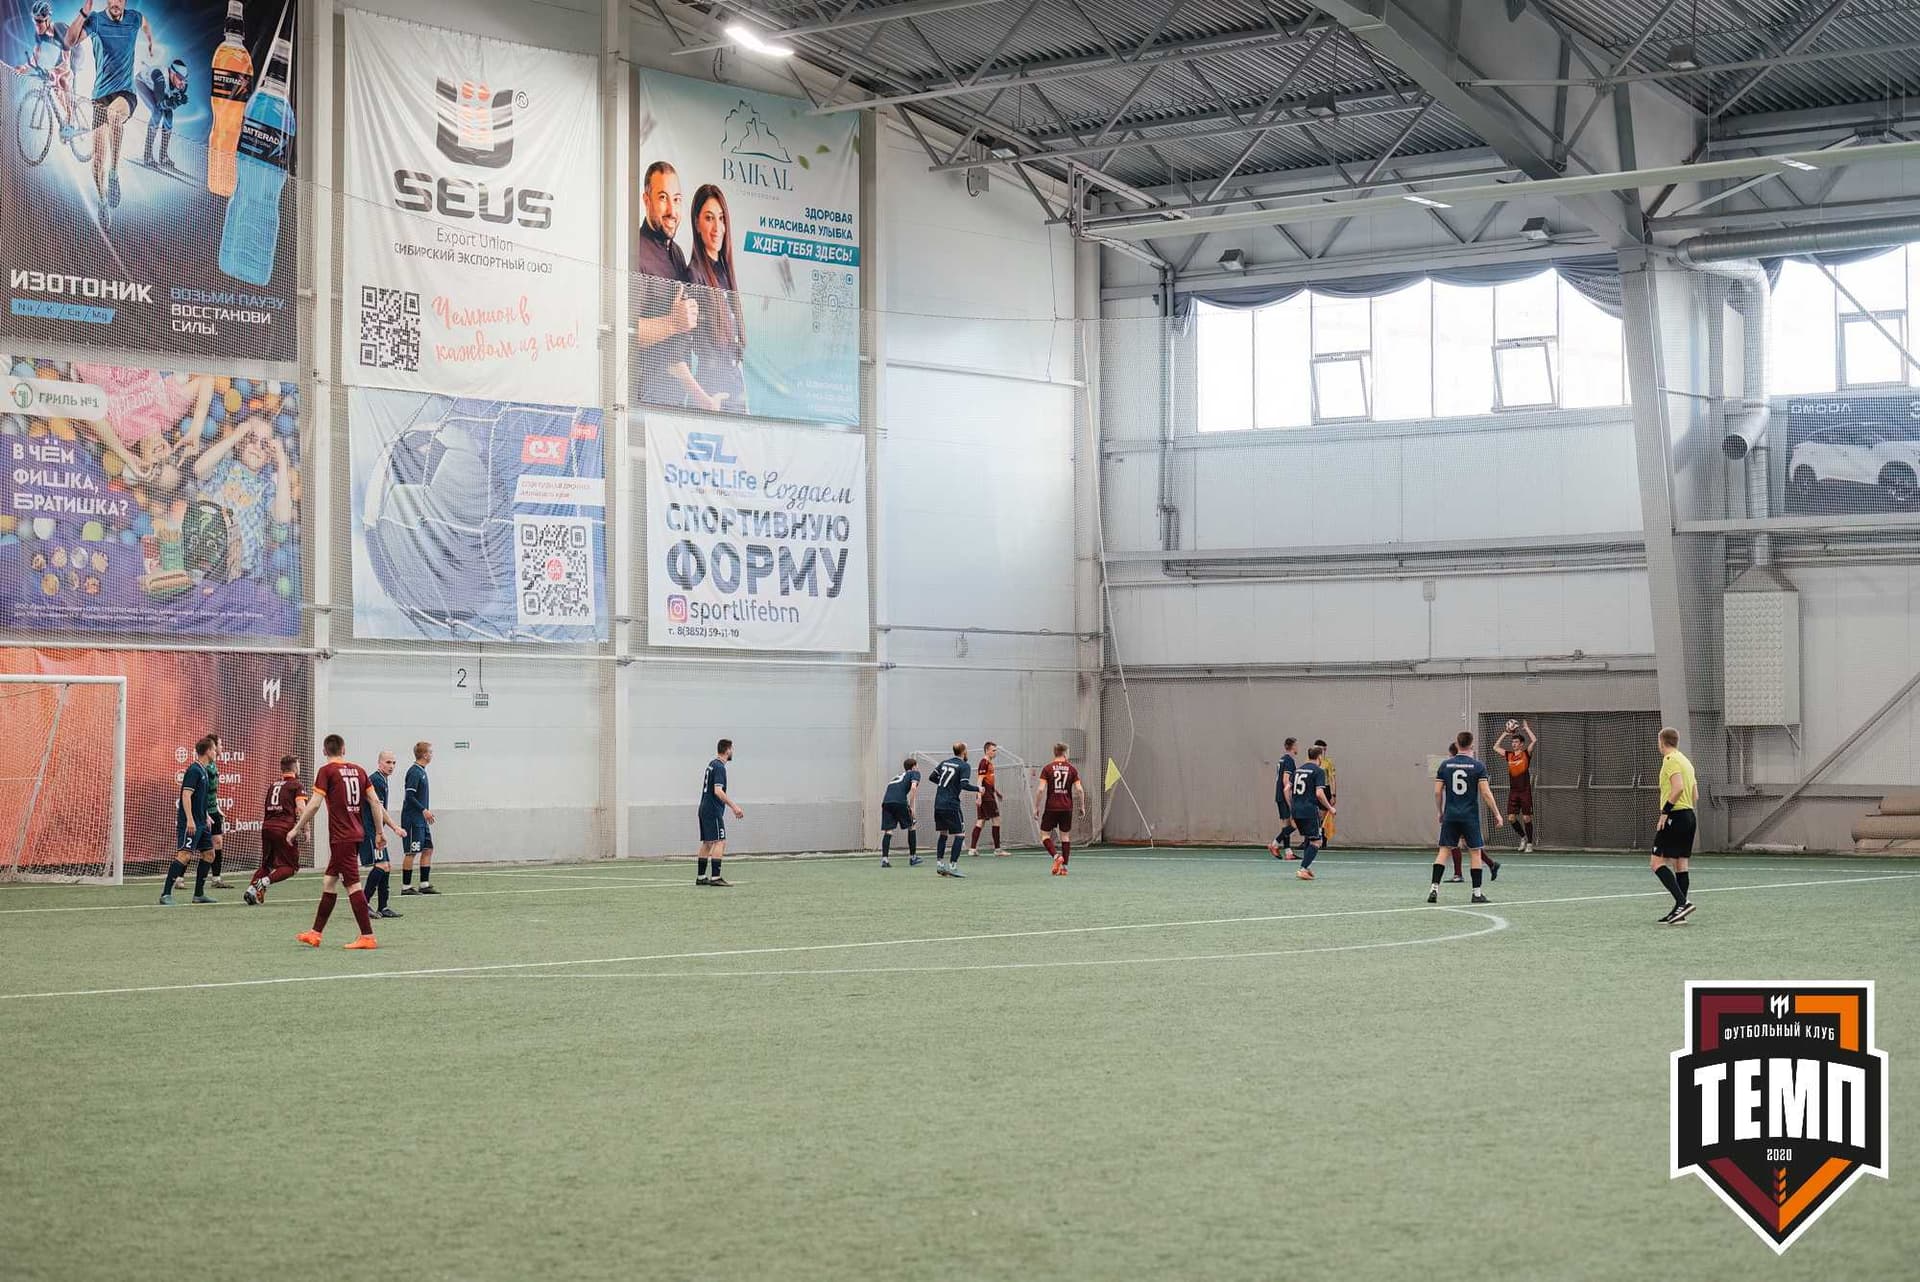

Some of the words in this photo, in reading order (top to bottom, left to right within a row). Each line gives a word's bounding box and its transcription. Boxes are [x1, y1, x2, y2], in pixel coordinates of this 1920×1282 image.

[722, 158, 793, 192] BAIKAL
[394, 169, 554, 229] SEUS
[760, 216, 766, 227] И
[768, 218, 816, 235] КРАСИВАЯ
[818, 226, 853, 240] УЛЫБКА
[804, 207, 853, 224] ЗДОРОВАЯ
[437, 227, 476, 249] Export
[479, 233, 513, 251] Union
[752, 235, 785, 253] ЖДЕТ
[787, 240, 813, 256] ТЕБЯ
[815, 245, 853, 262] ЗДЕСЬ!
[394, 242, 455, 262] СИБИРСКИЙ
[457, 252, 525, 270] ЭКСПОРТНЫЙ
[527, 261, 552, 274] СОЮЗ
[10, 269, 153, 303] ИЗОТОНИК
[171, 287, 234, 304] ВОЗЬМИ
[239, 294, 286, 310] ПАУЗУ
[172, 304, 271, 324] ВОССТАНОВИ
[172, 320, 218, 335] СИЛЫ.
[435, 329, 517, 362] каждом
[39, 392, 78, 406] ГРИЛЬ
[13, 443, 25, 460] В
[29, 439, 74, 464] ЧЁМ
[684, 431, 738, 464] SL
[13, 468, 98, 495] ФИШКА,
[664, 463, 757, 490] SportLife
[764, 471, 855, 510] Создаем
[14, 492, 129, 516] БРАТИШКА?
[666, 502, 851, 542] СПОРТИВНУЮ
[666, 539, 849, 598] ФОРМУ
[690, 598, 800, 626] sportlifebrn
[456, 668, 467, 688] 2
[343, 777, 360, 805] 19
[1053, 770, 1068, 789] 27
[1452, 769, 1468, 795] 6
[271, 785, 282, 806] 8
[185, 837, 193, 848] 2
